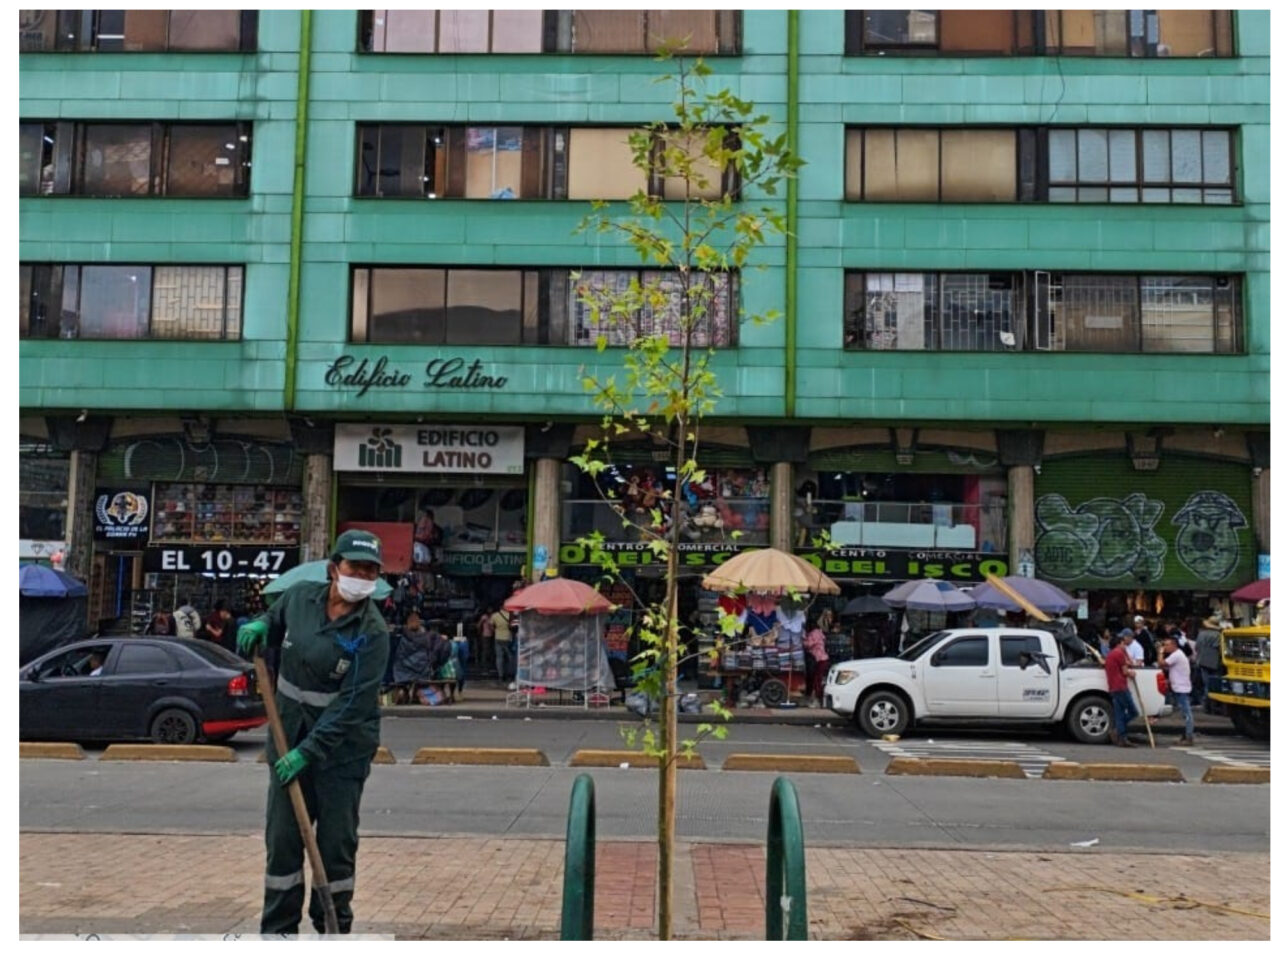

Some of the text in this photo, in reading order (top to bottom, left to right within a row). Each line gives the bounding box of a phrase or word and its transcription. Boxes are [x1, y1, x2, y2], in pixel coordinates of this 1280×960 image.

[324, 354, 509, 398] Edificio Latino
[416, 428, 500, 447] EDIFICIO
[422, 451, 492, 469] LATINO
[599, 542, 740, 552] ENTRO OMERCIAL
[161, 550, 191, 570] EL
[201, 550, 233, 571] 10
[253, 550, 286, 571] 47
